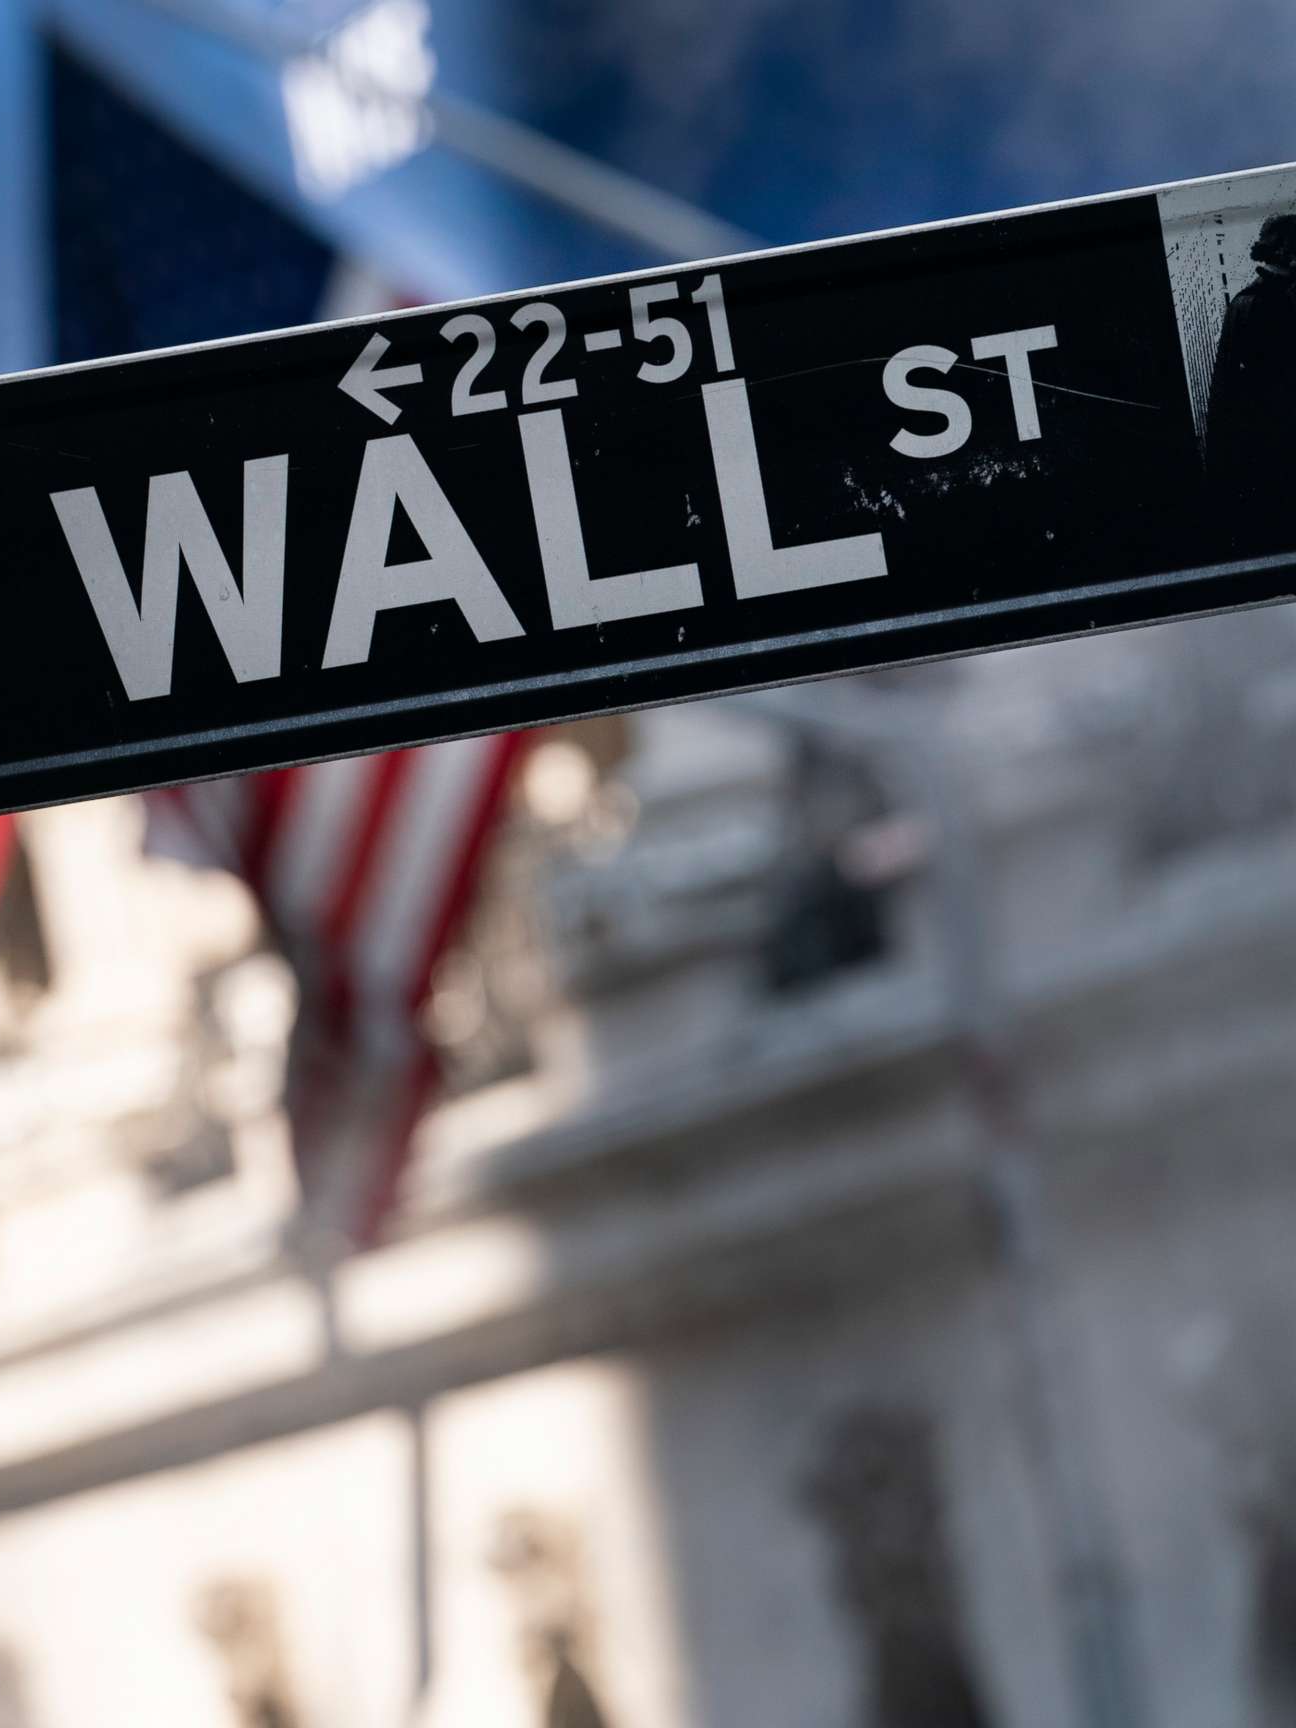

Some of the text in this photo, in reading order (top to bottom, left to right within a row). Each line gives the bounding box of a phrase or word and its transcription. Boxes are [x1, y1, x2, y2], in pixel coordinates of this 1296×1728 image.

[438, 273, 736, 417] 22-51
[49, 325, 1058, 702] WALL ST
